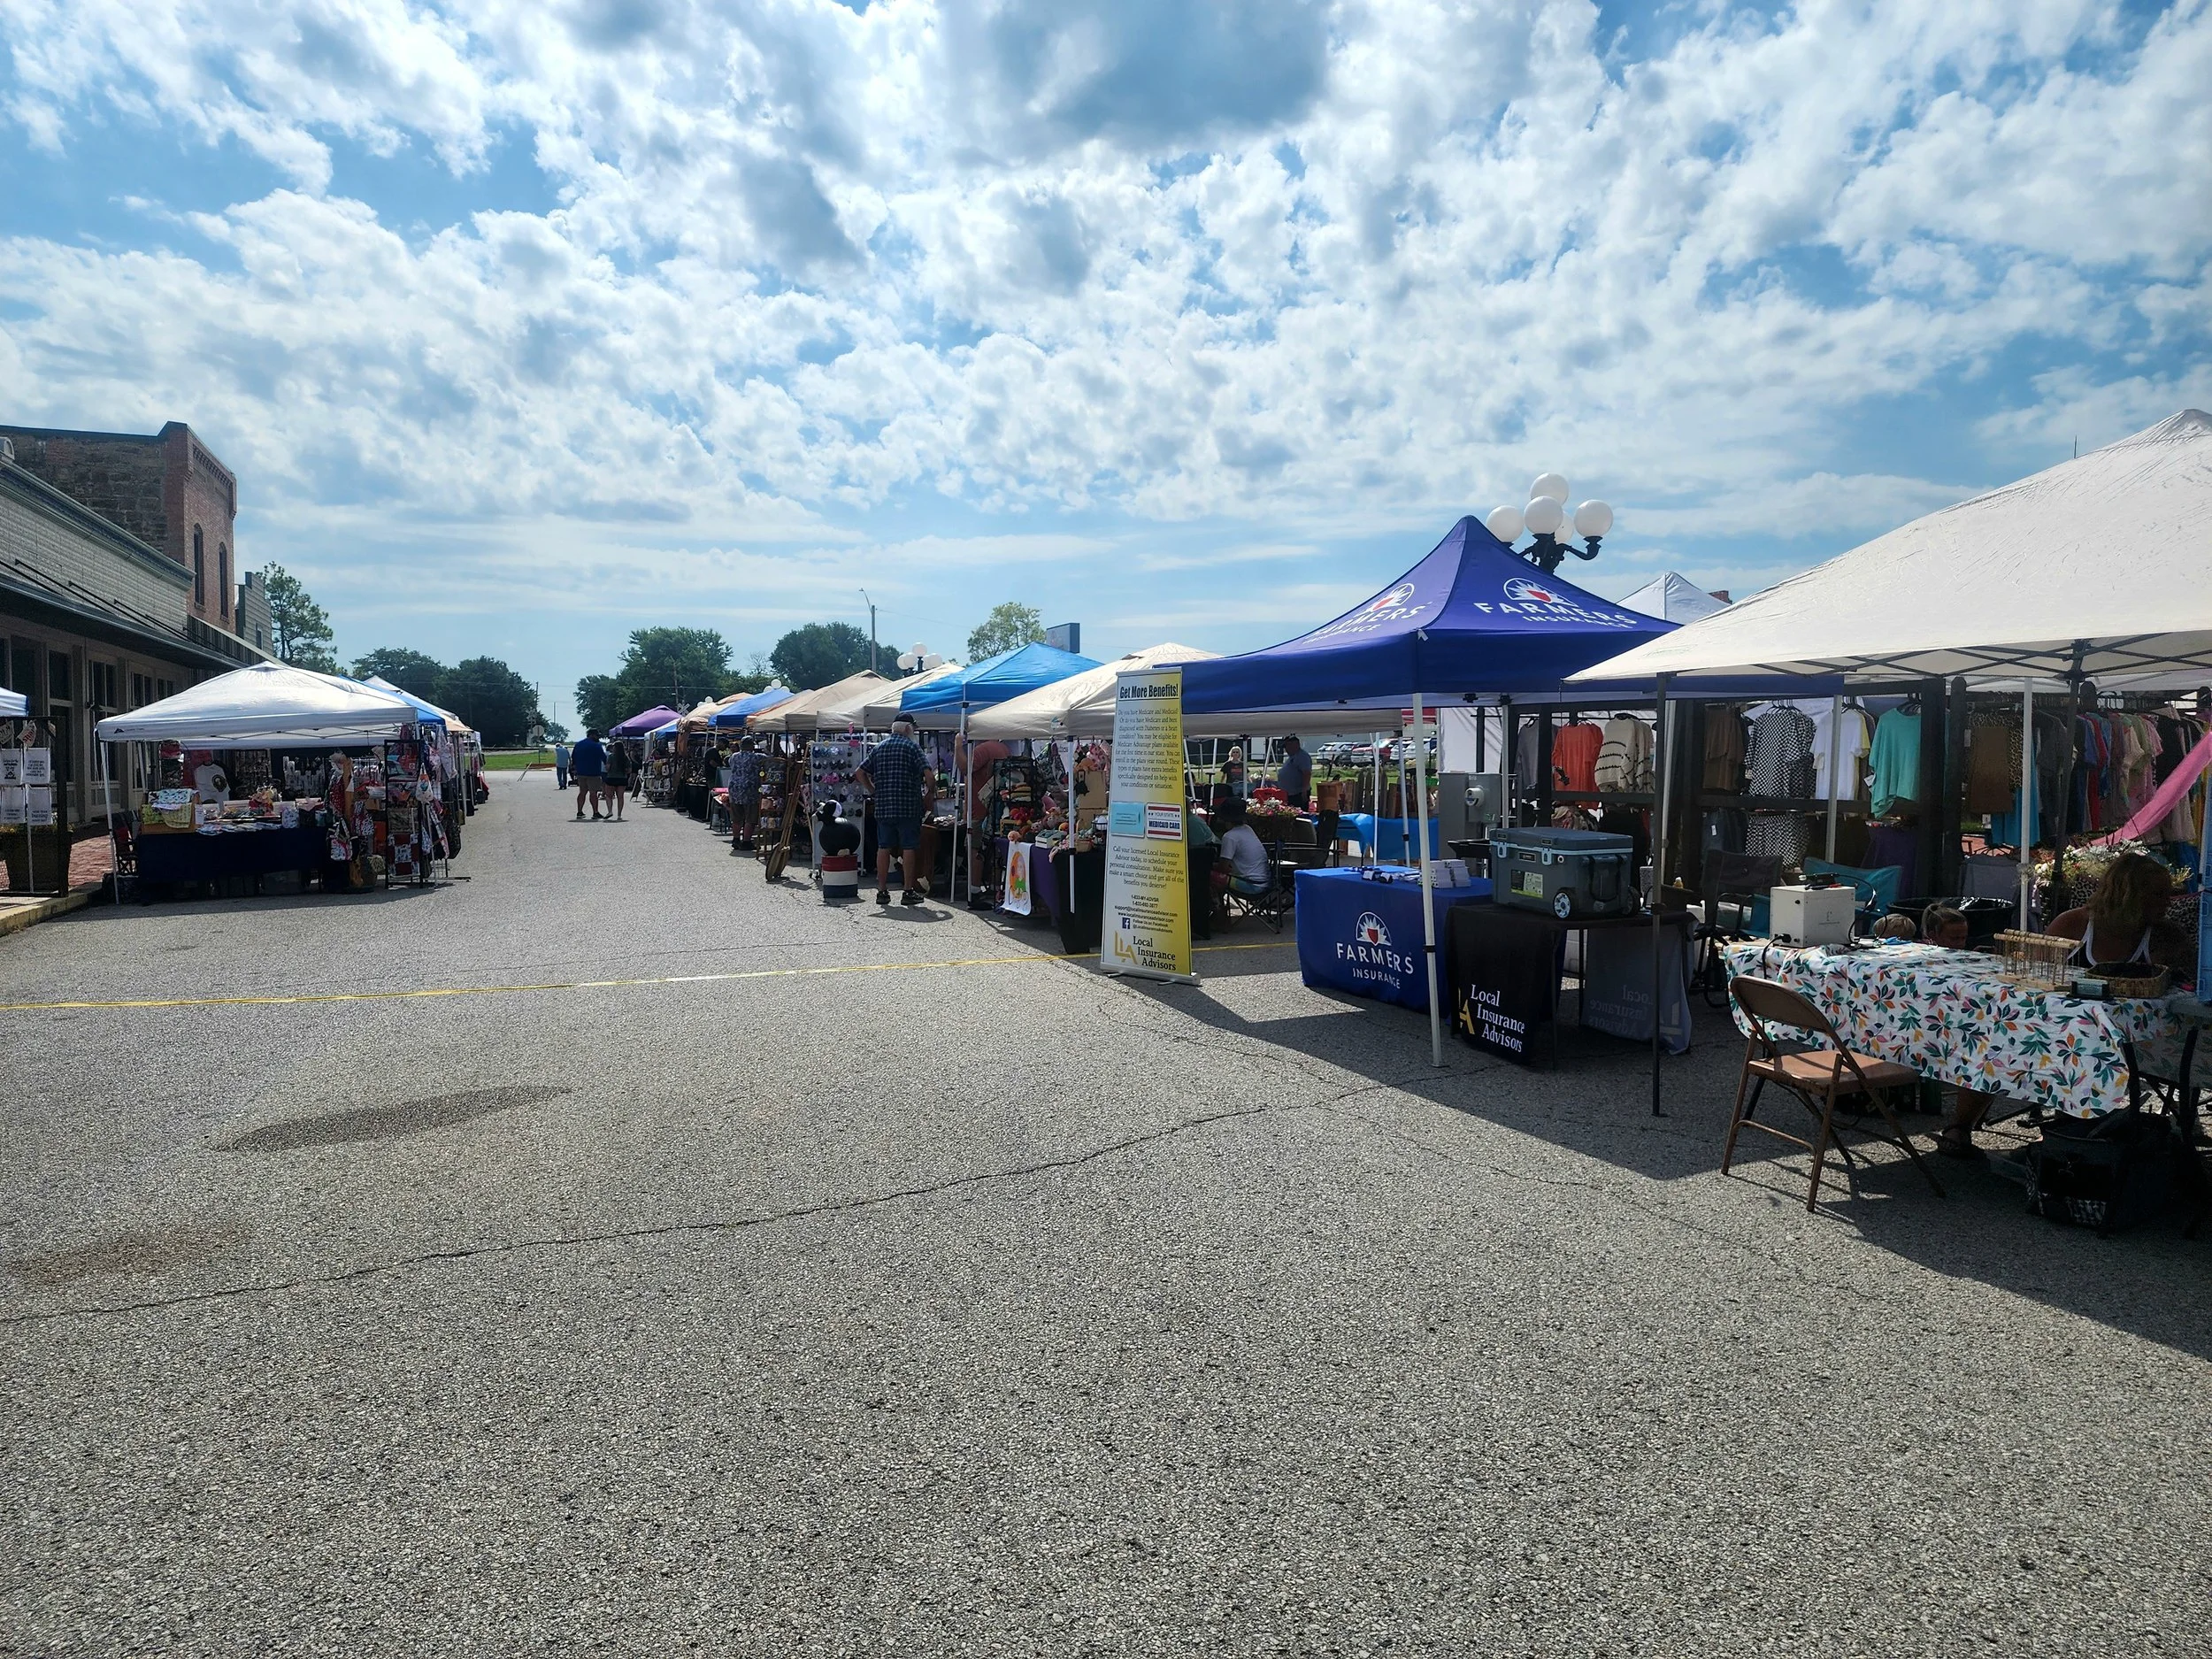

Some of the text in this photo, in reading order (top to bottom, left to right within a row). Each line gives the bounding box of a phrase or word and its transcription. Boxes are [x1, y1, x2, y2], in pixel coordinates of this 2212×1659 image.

[1473, 603, 1637, 625] FARMERS
[1523, 616, 1633, 629] INSURANCE
[1119, 683, 1179, 699] Get More Benefits!
[1133, 935, 1153, 947] Local
[1137, 946, 1176, 961] Insurance
[1141, 956, 1176, 971] Advisors
[1336, 942, 1414, 974] FARMERS
[1352, 967, 1401, 989] INSURANCE
[1471, 984, 1501, 1007] Local
[1477, 1003, 1525, 1034] Insurance
[1481, 1023, 1523, 1053] Advisors
